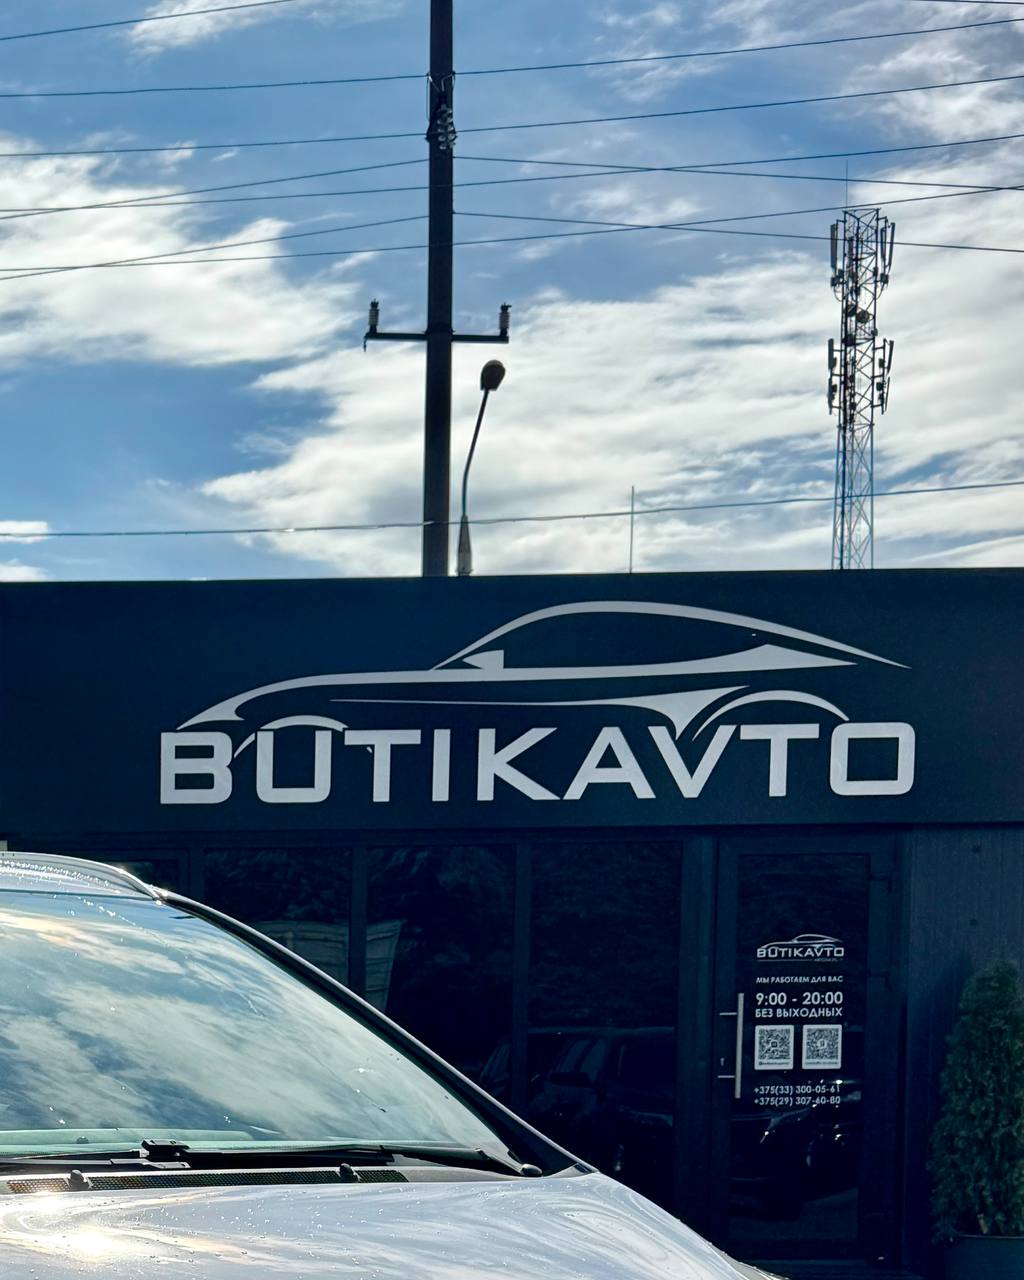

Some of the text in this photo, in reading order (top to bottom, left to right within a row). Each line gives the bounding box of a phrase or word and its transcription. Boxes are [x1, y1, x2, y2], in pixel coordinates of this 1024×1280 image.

[159, 721, 917, 805] BUTIKAVTO
[756, 947, 845, 958] BUTIKAVTO
[756, 975, 844, 984] МЫ РАБОТАЕМ ДЛЯ ВАС
[755, 992, 787, 1006] 9:00
[802, 991, 844, 1005] 20:00
[755, 1007, 843, 1018] БЕЗ ВЫХОДНЫХ
[754, 1085, 793, 1096] +375(33)
[754, 1096, 793, 1107] +375(29)
